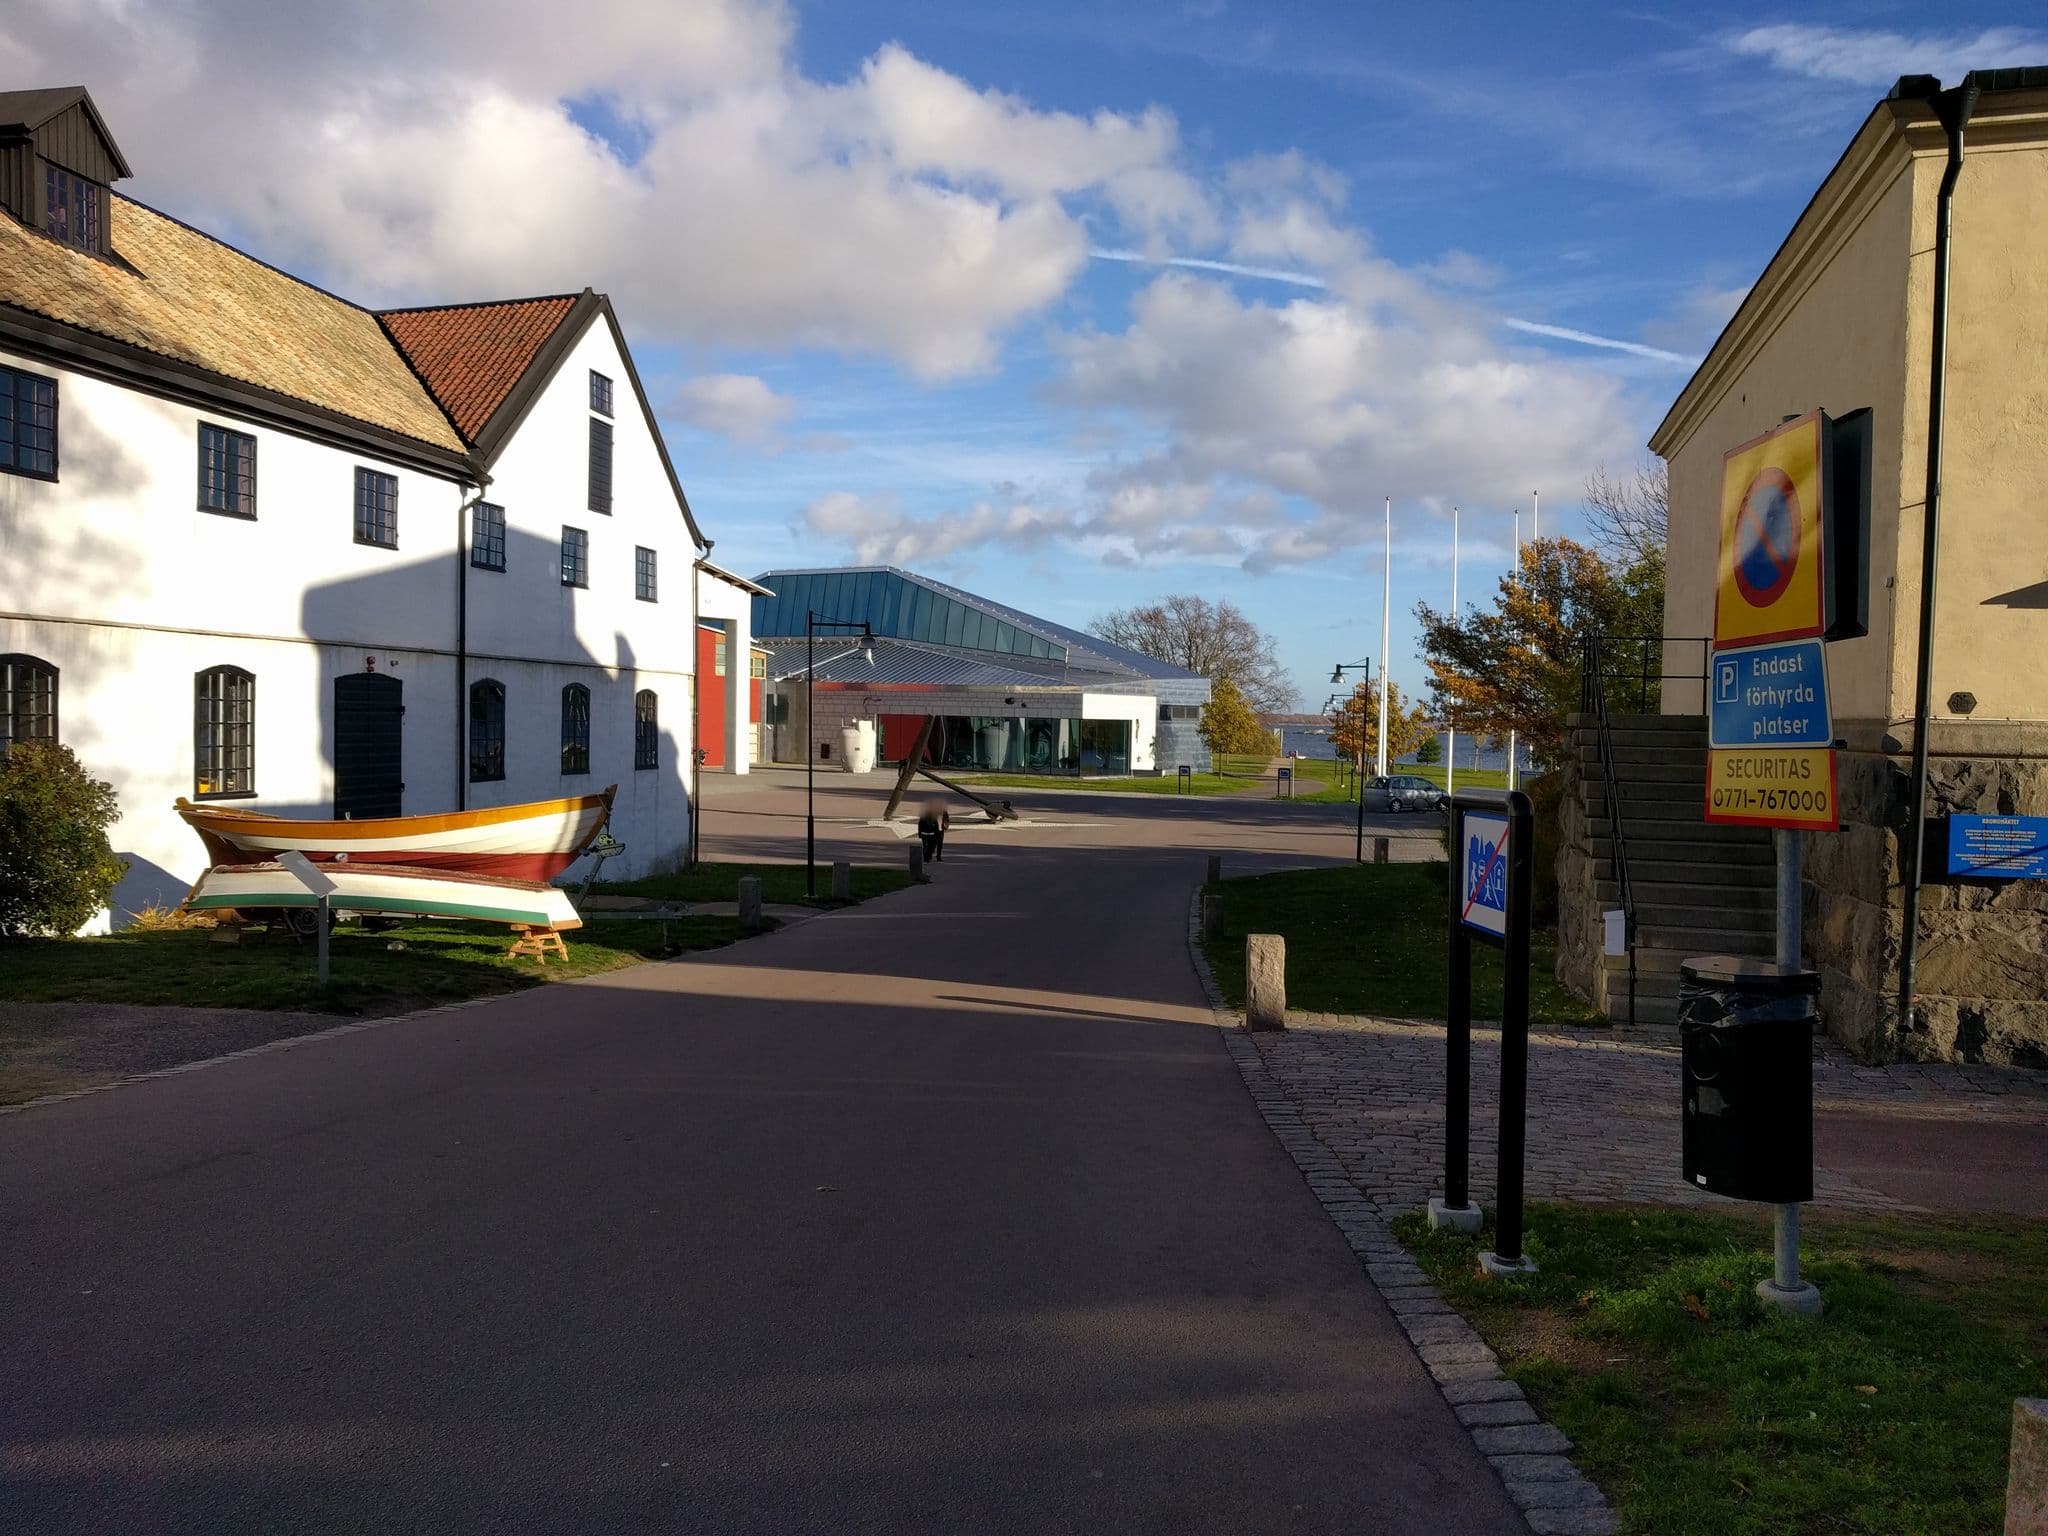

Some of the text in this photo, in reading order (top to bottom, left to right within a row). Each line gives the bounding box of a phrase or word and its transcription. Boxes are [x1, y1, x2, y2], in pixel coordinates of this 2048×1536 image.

[1753, 653, 1803, 677] Endast
[1721, 666, 1734, 698] P
[1746, 684, 1814, 709] förhyrda
[1753, 716, 1809, 740] platser
[1726, 758, 1811, 780] SECURITAS
[1713, 788, 1827, 812] 0771-767000
